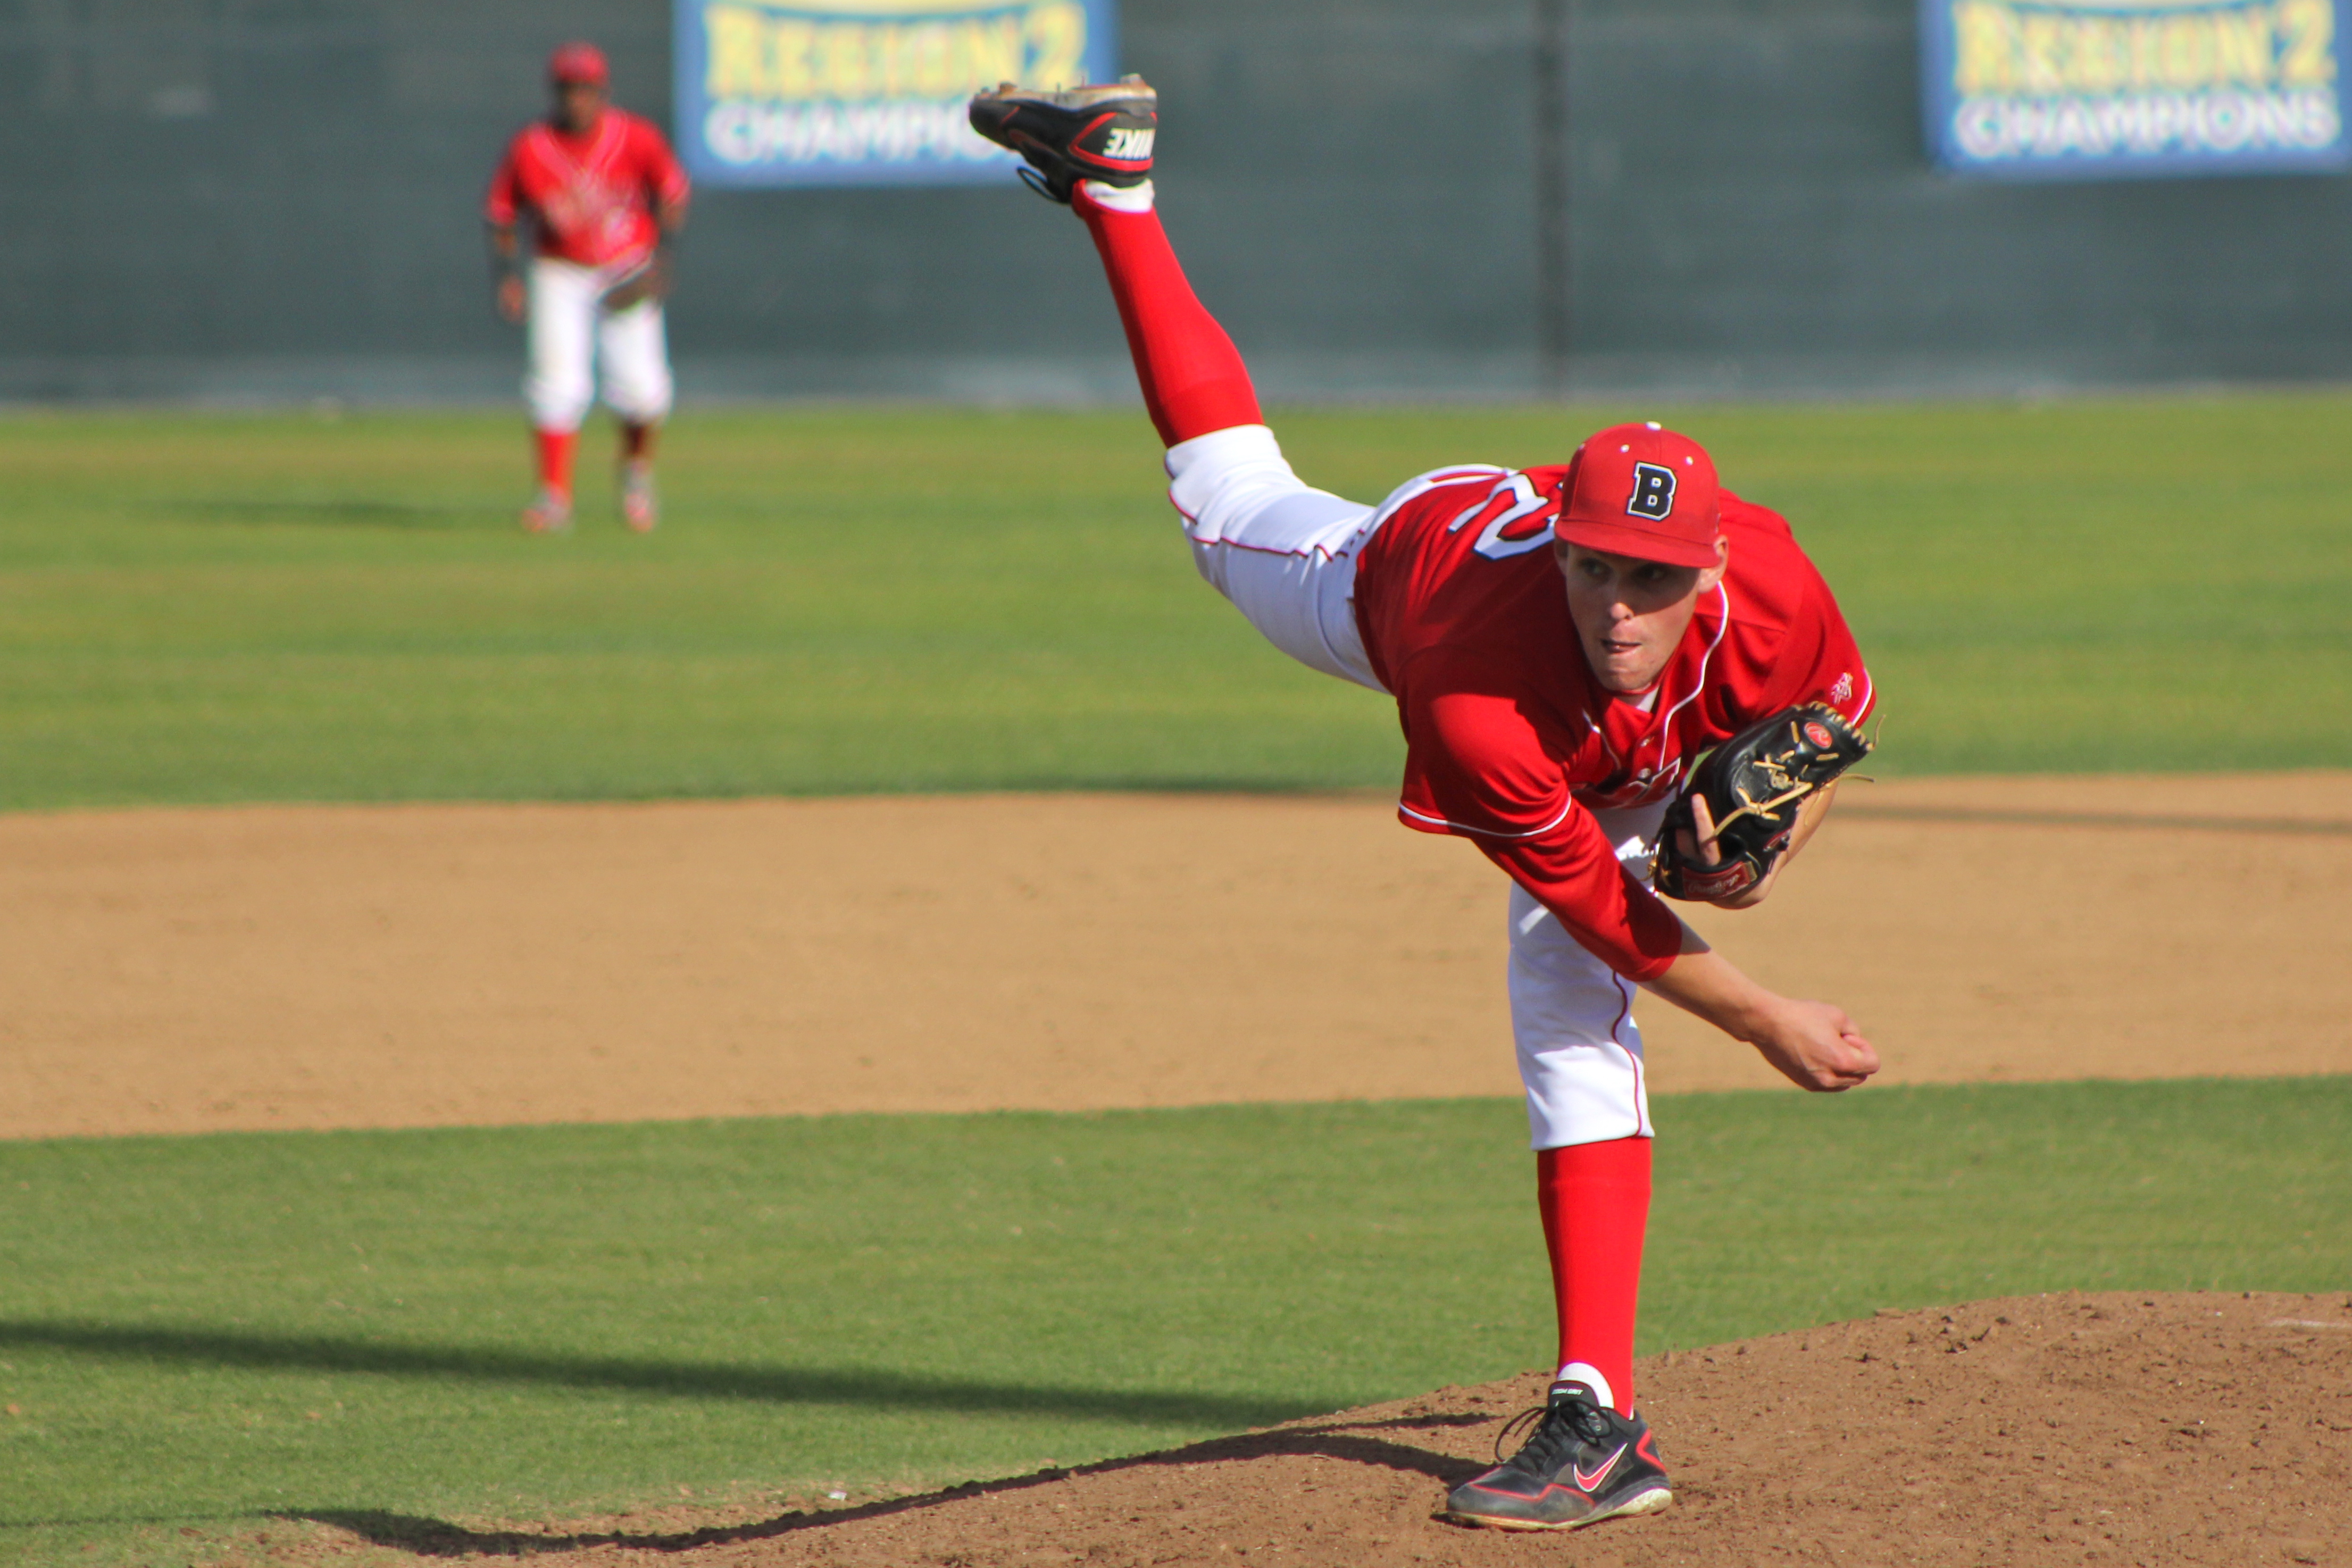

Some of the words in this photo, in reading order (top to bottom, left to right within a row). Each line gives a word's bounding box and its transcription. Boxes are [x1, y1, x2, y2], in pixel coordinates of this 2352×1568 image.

[1102, 128, 1156, 160] NIKE
[1953, 87, 2341, 160] CHAMPIONS
[1626, 461, 1678, 522] B
